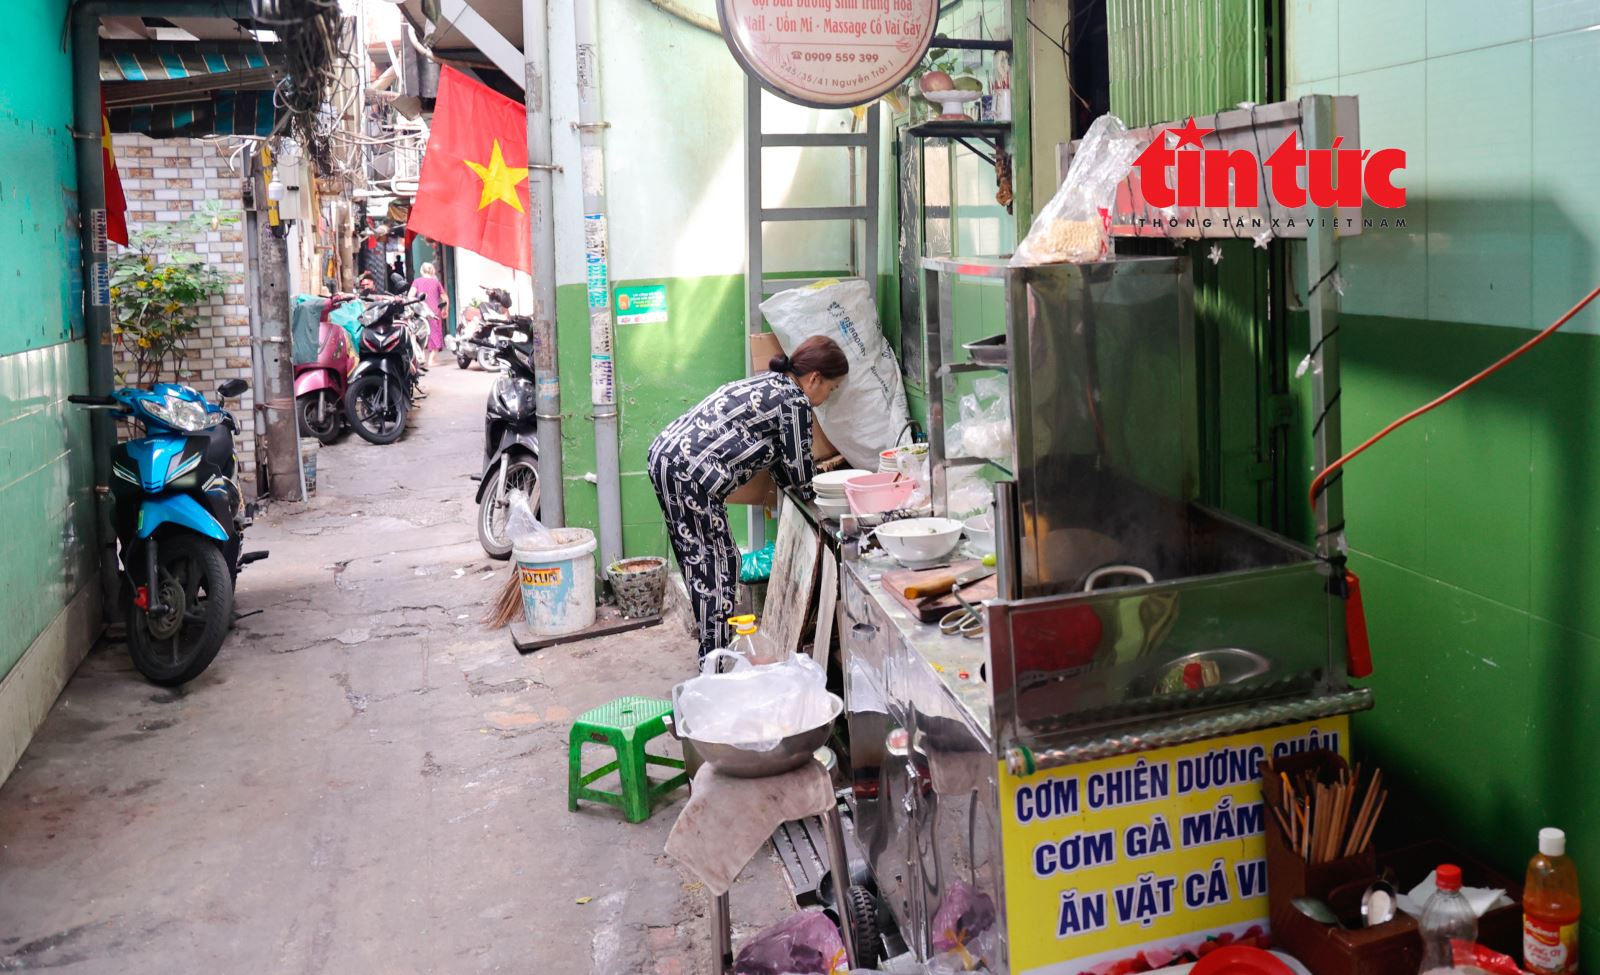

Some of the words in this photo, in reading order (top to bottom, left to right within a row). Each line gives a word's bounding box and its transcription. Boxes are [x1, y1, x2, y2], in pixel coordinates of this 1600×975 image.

[804, 52, 832, 62] 0909
[836, 53, 856, 62] 559
[858, 54, 879, 62] 399
[824, 18, 866, 38] Massage
[1016, 779, 1078, 822] CƠM
[1088, 760, 1169, 808] CHIÊN
[1178, 745, 1264, 793] DƯƠNG
[1036, 834, 1113, 876] CƠM
[1126, 817, 1172, 857] GÀ
[1183, 798, 1265, 846] MẮM
[1059, 894, 1104, 936] ĂN
[1116, 875, 1175, 924] VẶT
[1186, 861, 1228, 907] CÁ
